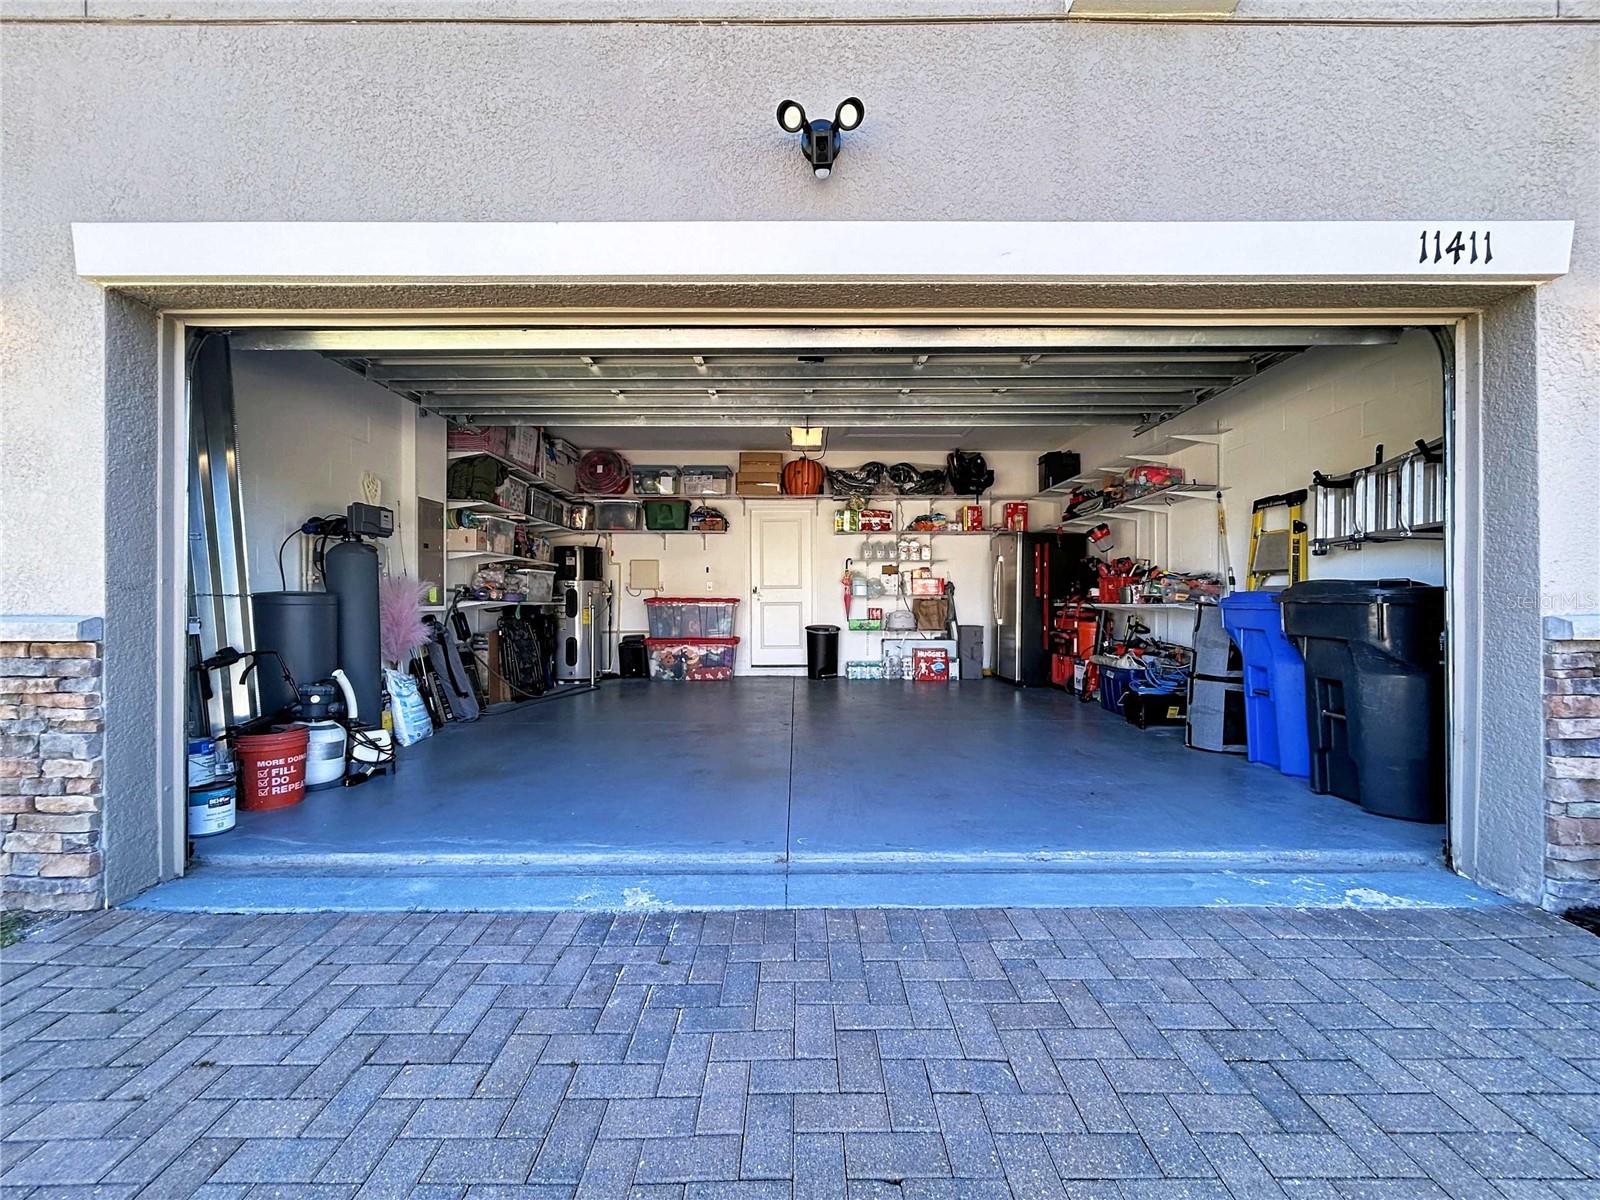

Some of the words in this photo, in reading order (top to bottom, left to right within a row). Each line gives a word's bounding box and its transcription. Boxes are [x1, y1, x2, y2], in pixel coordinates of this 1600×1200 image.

[1419, 230, 1493, 265] 11411
[917, 650, 946, 658] HUGGIES
[257, 758, 286, 768] MORE
[271, 765, 297, 777] FILL
[271, 776, 290, 786] DO
[271, 780, 305, 795] REPEA
